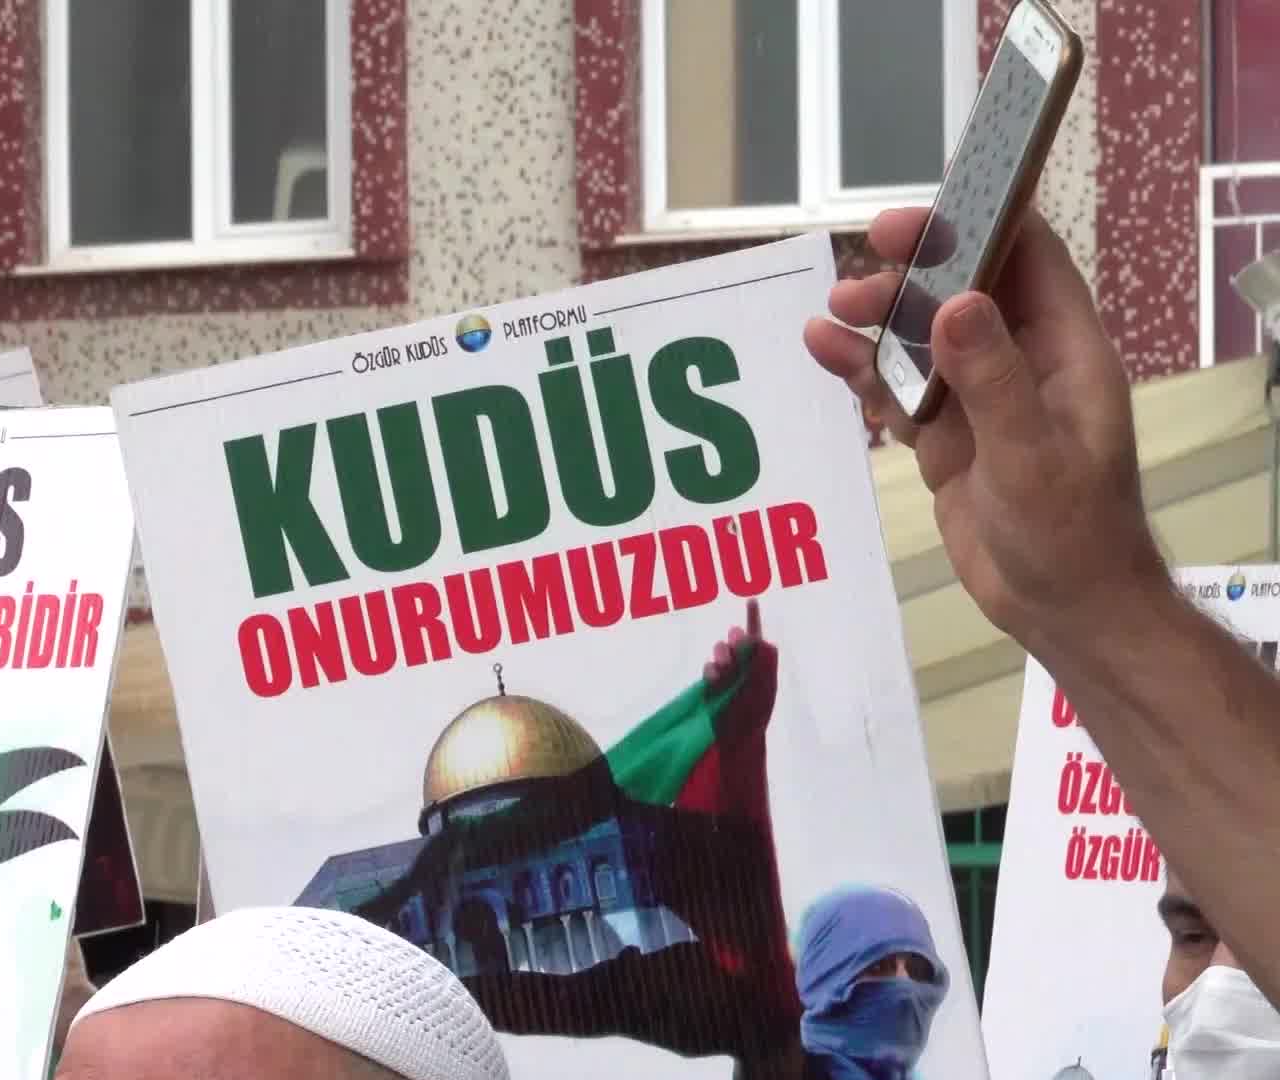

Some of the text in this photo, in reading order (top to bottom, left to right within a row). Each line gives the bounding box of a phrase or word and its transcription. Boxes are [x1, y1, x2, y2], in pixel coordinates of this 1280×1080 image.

[352, 304, 588, 374] ÖZGÜR KUDÜS PLATFORMU
[223, 327, 761, 599] KUDÜS
[238, 501, 829, 698] ONURUMUZDUR
[1057, 751, 1136, 816] ÖZG
